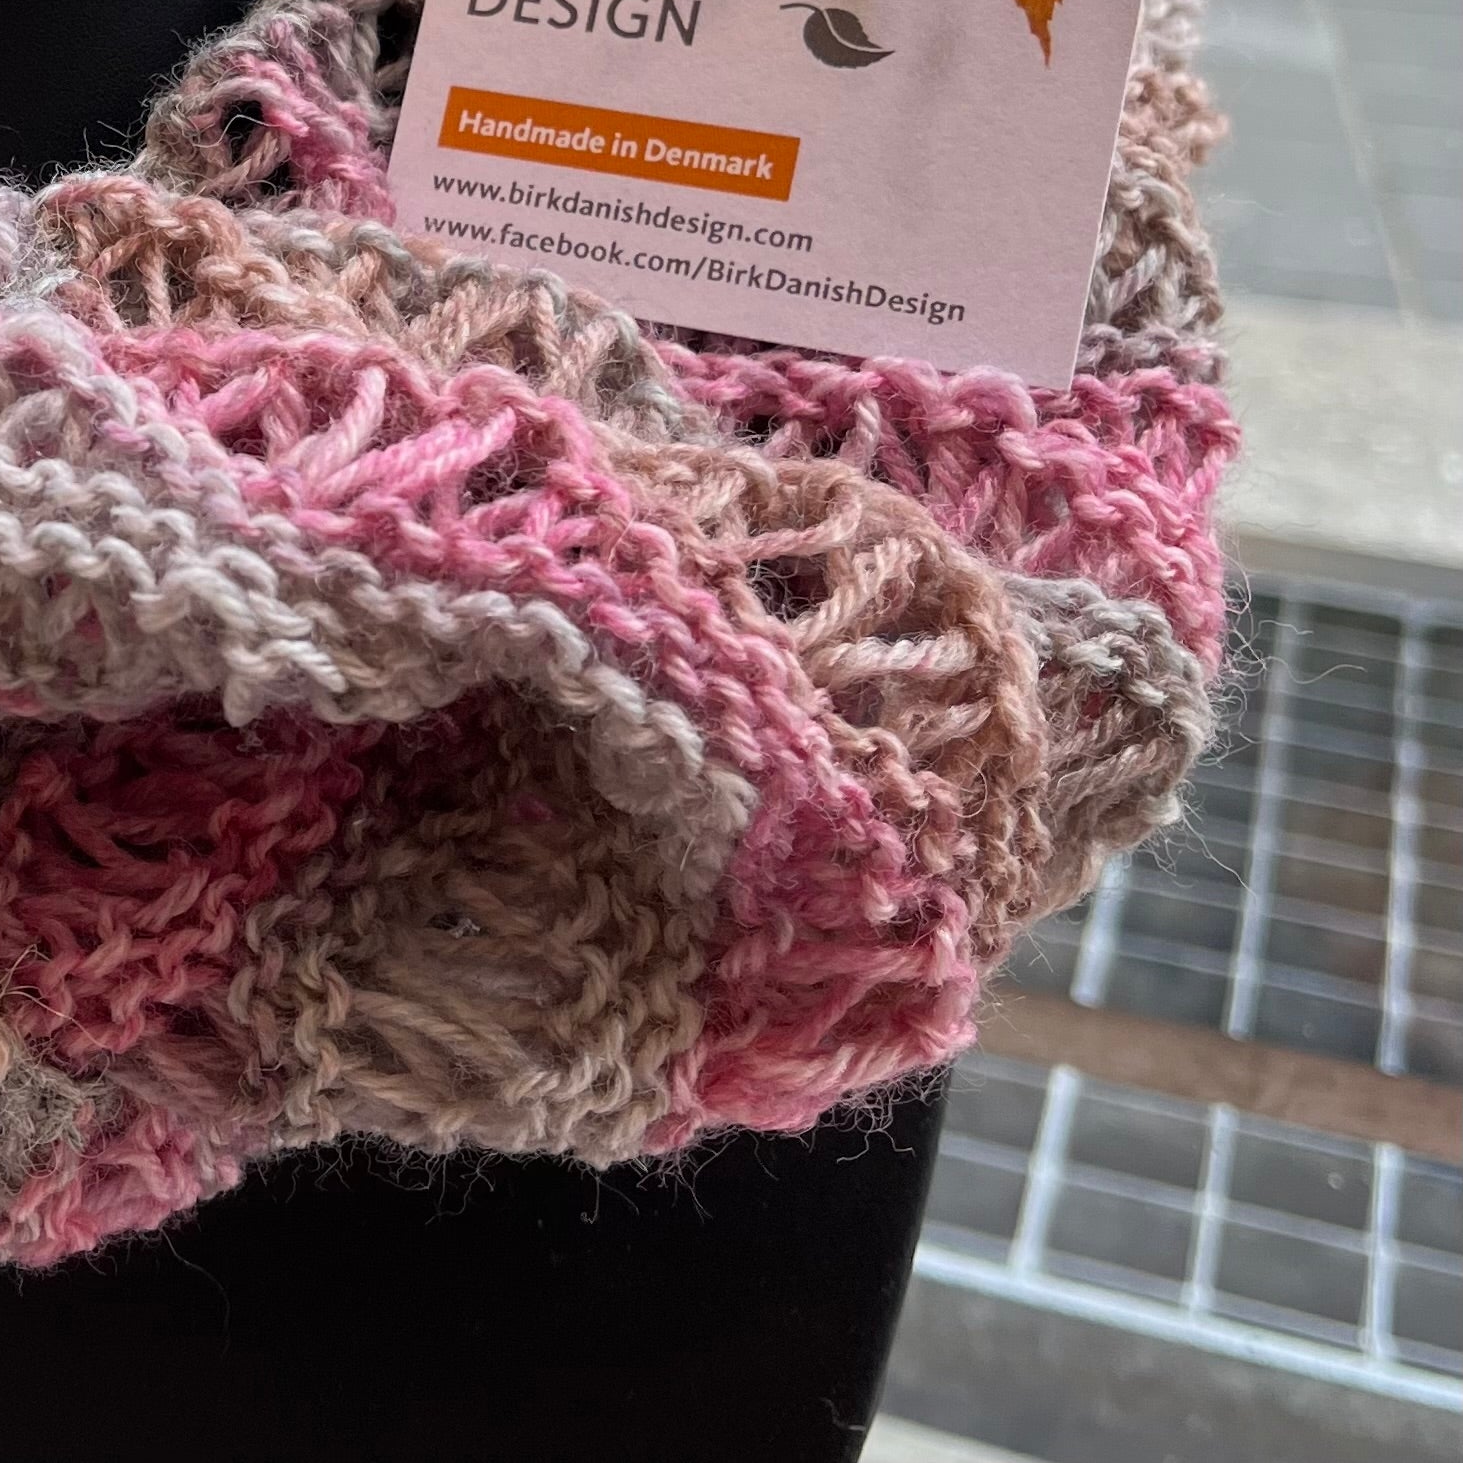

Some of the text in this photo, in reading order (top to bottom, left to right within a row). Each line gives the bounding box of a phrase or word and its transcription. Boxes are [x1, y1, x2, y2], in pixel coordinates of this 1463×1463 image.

[458, 109, 774, 180] Handmade in Denmark
[432, 174, 814, 253] www.birkdanishdesign.com
[423, 216, 967, 325] www.facebook.com/BirkDanishDesign
